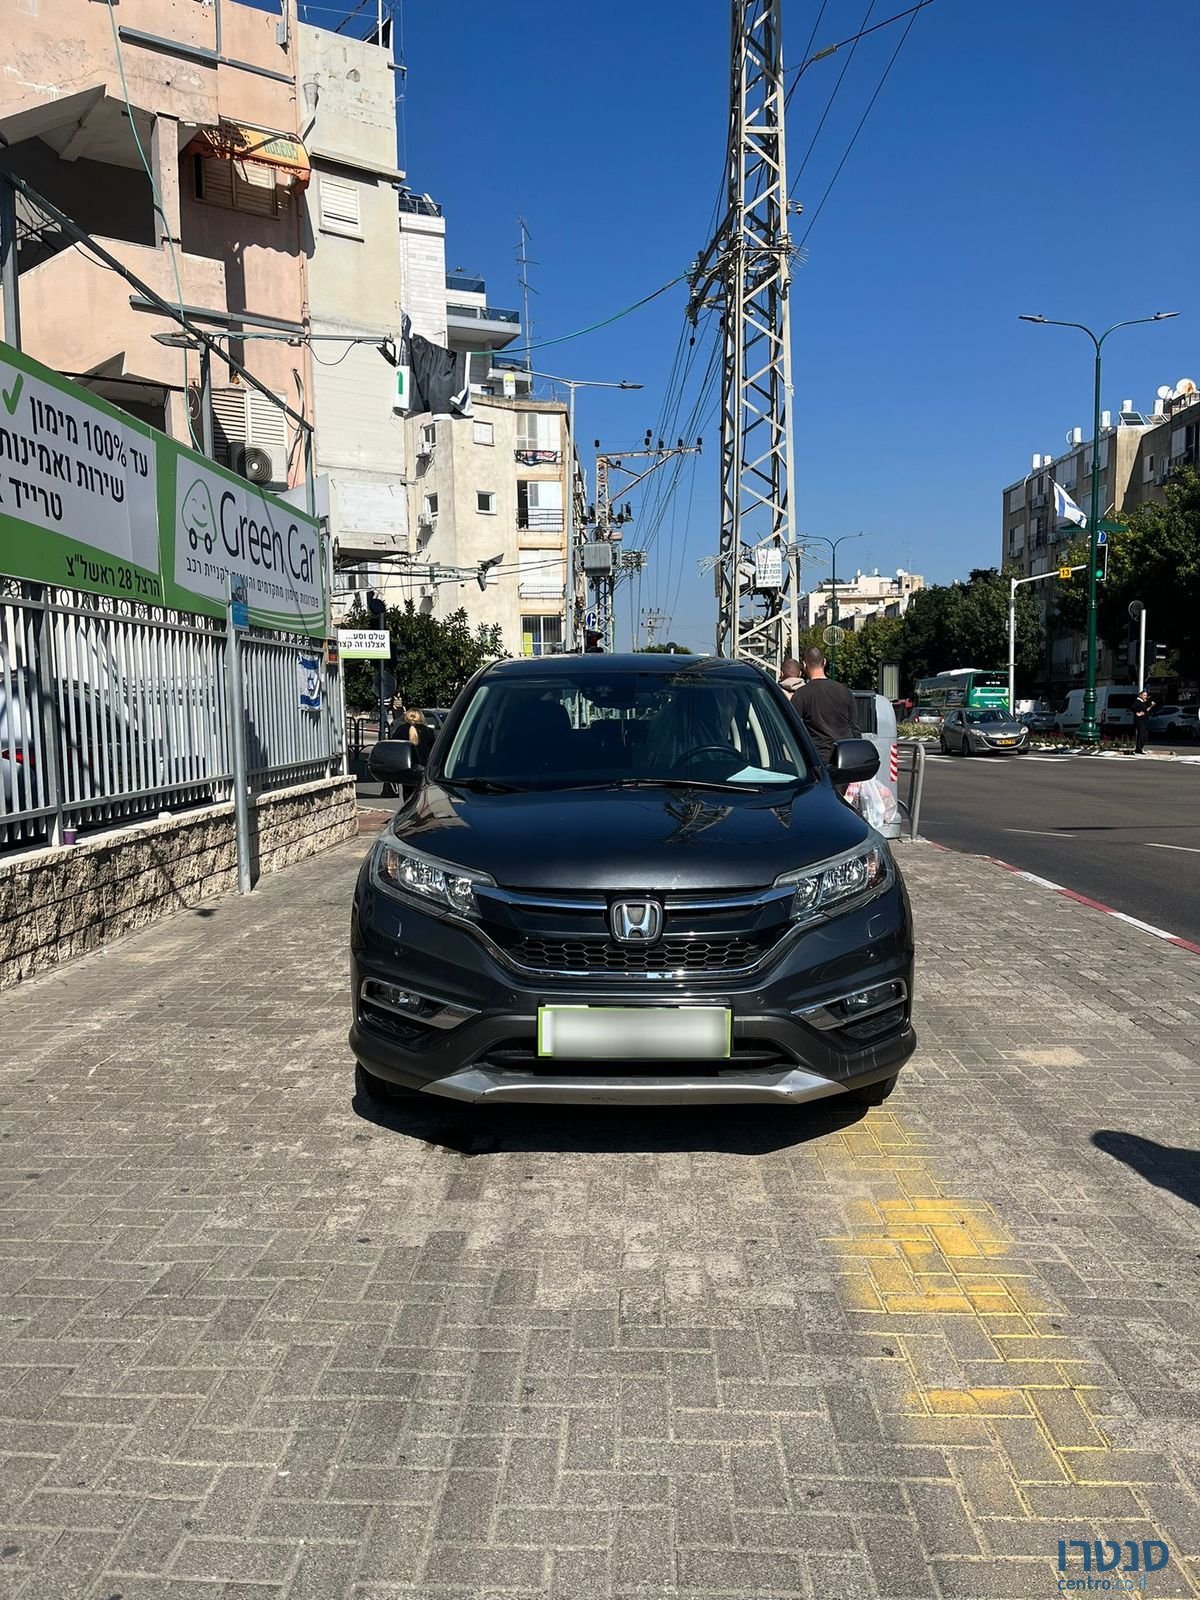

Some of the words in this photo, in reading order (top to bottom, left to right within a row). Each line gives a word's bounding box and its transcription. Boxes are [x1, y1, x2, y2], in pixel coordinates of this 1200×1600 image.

[29, 396, 79, 446] מימון
[83, 420, 127, 468] 100%
[129, 447, 149, 478] עד
[76, 460, 125, 503] שירות
[8, 476, 63, 521] טרייד
[220, 491, 285, 575] Green
[287, 524, 316, 585] Car
[117, 566, 133, 590] 28
[186, 557, 202, 574] רכב
[1061, 569, 1070, 577] 13
[134, 570, 160, 597] הרצל
[365, 640, 386, 649] אצלנו
[368, 632, 385, 640] שלם
